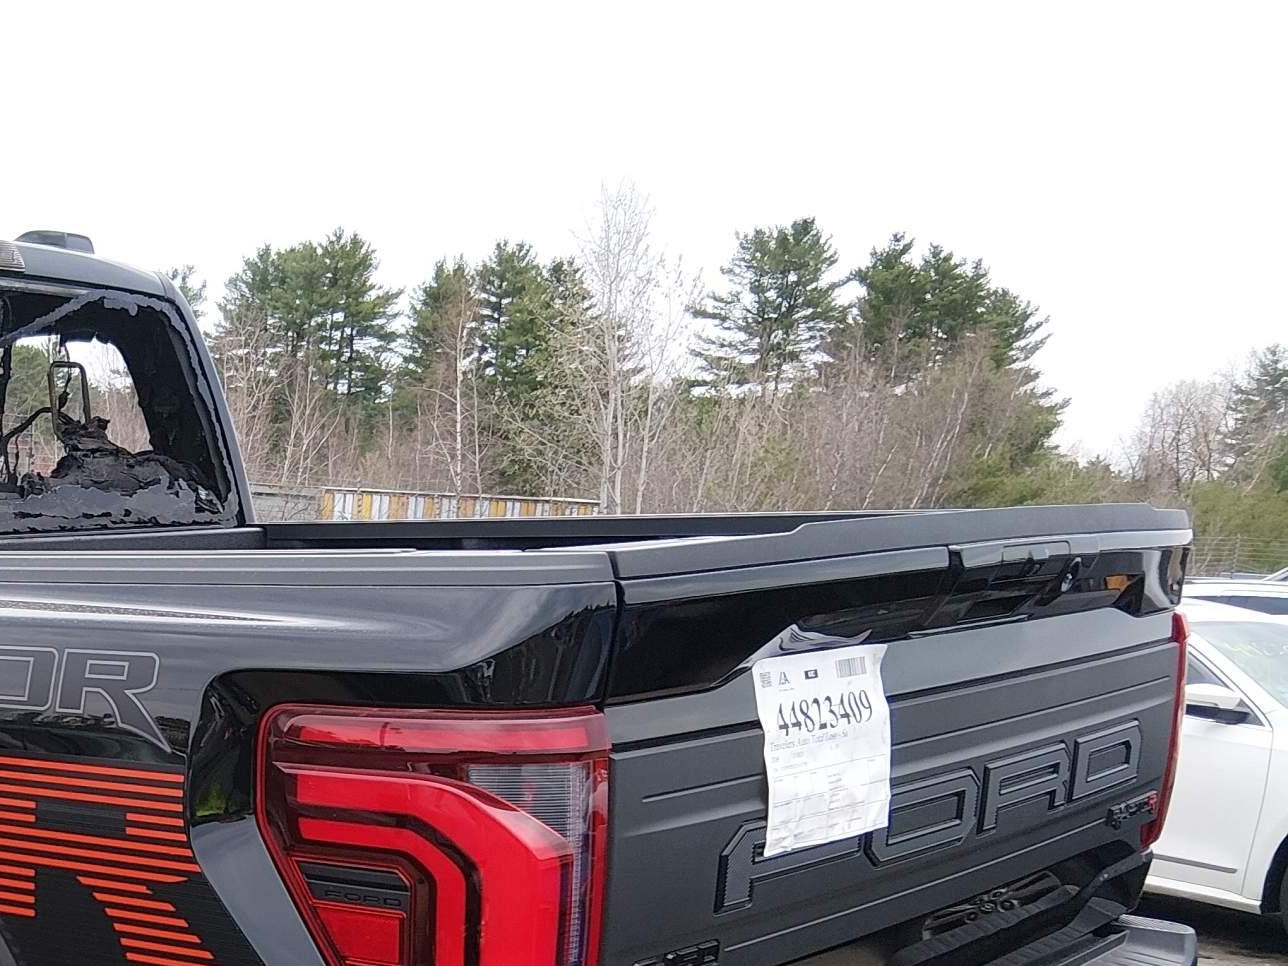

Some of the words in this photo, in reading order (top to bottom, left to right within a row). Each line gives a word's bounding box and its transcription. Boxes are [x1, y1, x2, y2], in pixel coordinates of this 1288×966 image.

[776, 689, 873, 737] 44823409
[714, 718, 1141, 916] FORD
[324, 889, 402, 906] FORD
